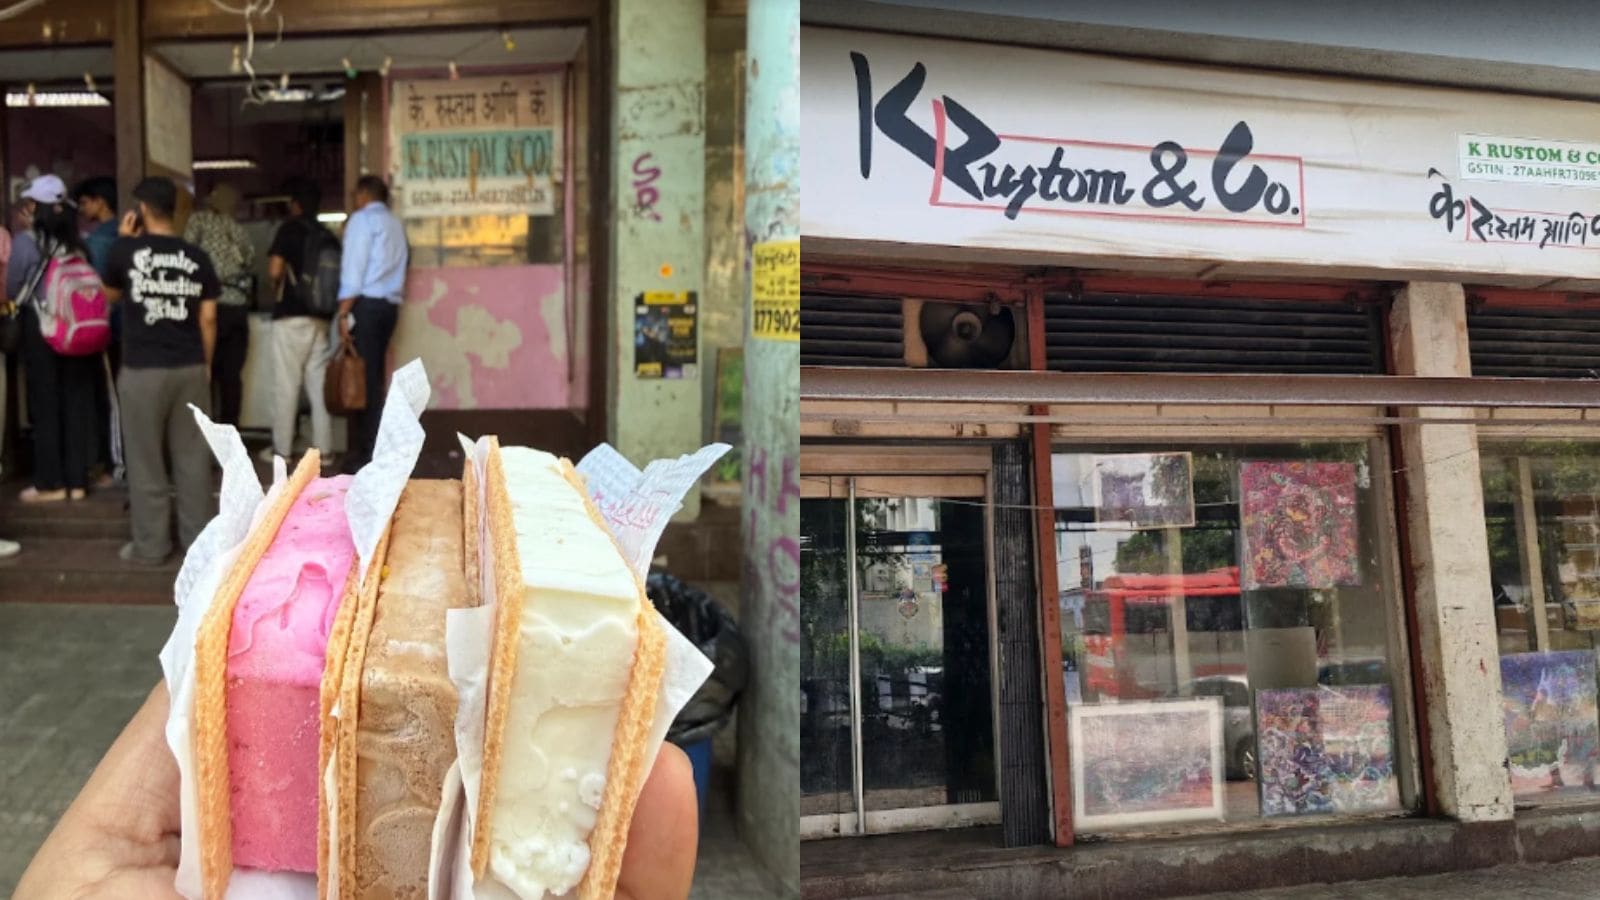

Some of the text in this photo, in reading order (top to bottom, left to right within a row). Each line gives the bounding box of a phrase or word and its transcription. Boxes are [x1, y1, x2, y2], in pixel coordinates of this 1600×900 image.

[1467, 141, 1600, 165] K RUSTOM & C
[1142, 140, 1206, 212] &
[1211, 120, 1300, 216] Co.
[1467, 162, 1504, 175] GSTIN
